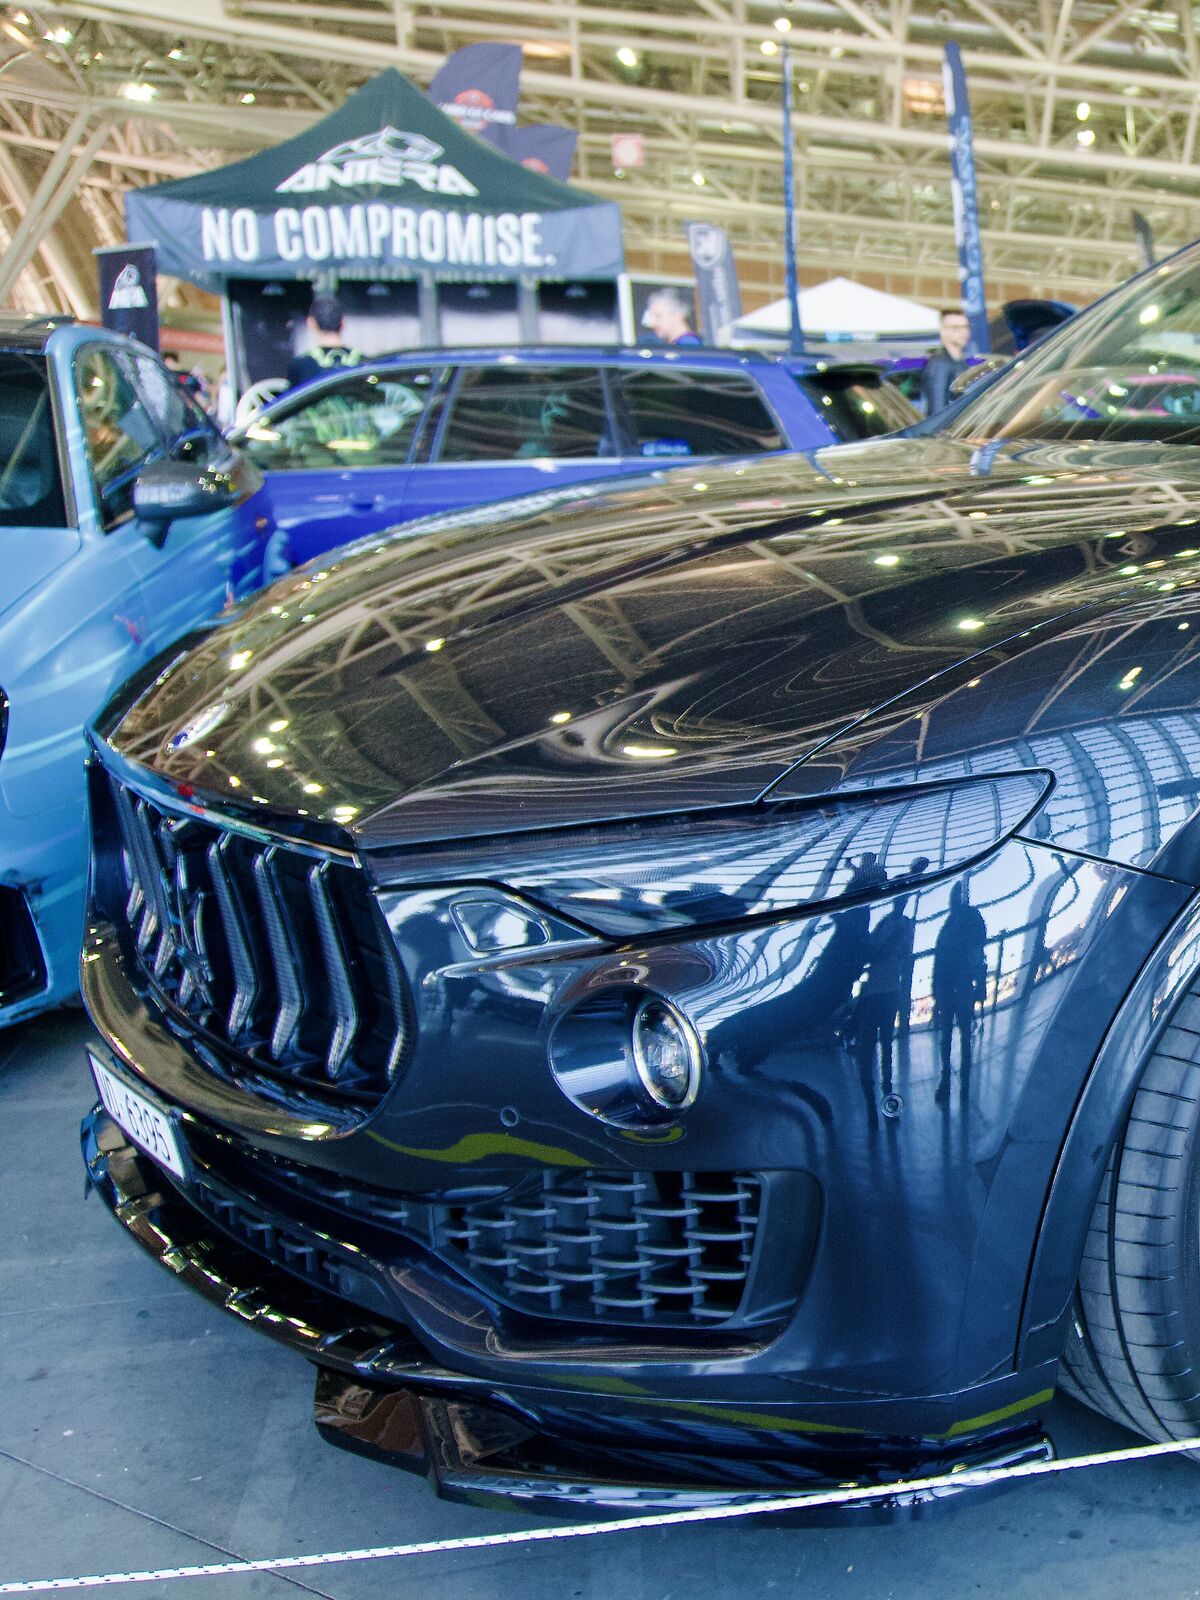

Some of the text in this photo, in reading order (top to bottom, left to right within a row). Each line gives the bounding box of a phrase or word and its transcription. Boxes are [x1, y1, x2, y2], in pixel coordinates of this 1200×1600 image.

[275, 157, 479, 196] ANTERA
[201, 204, 557, 267] NO COMPROMISE.
[125, 1094, 171, 1161] 6395
